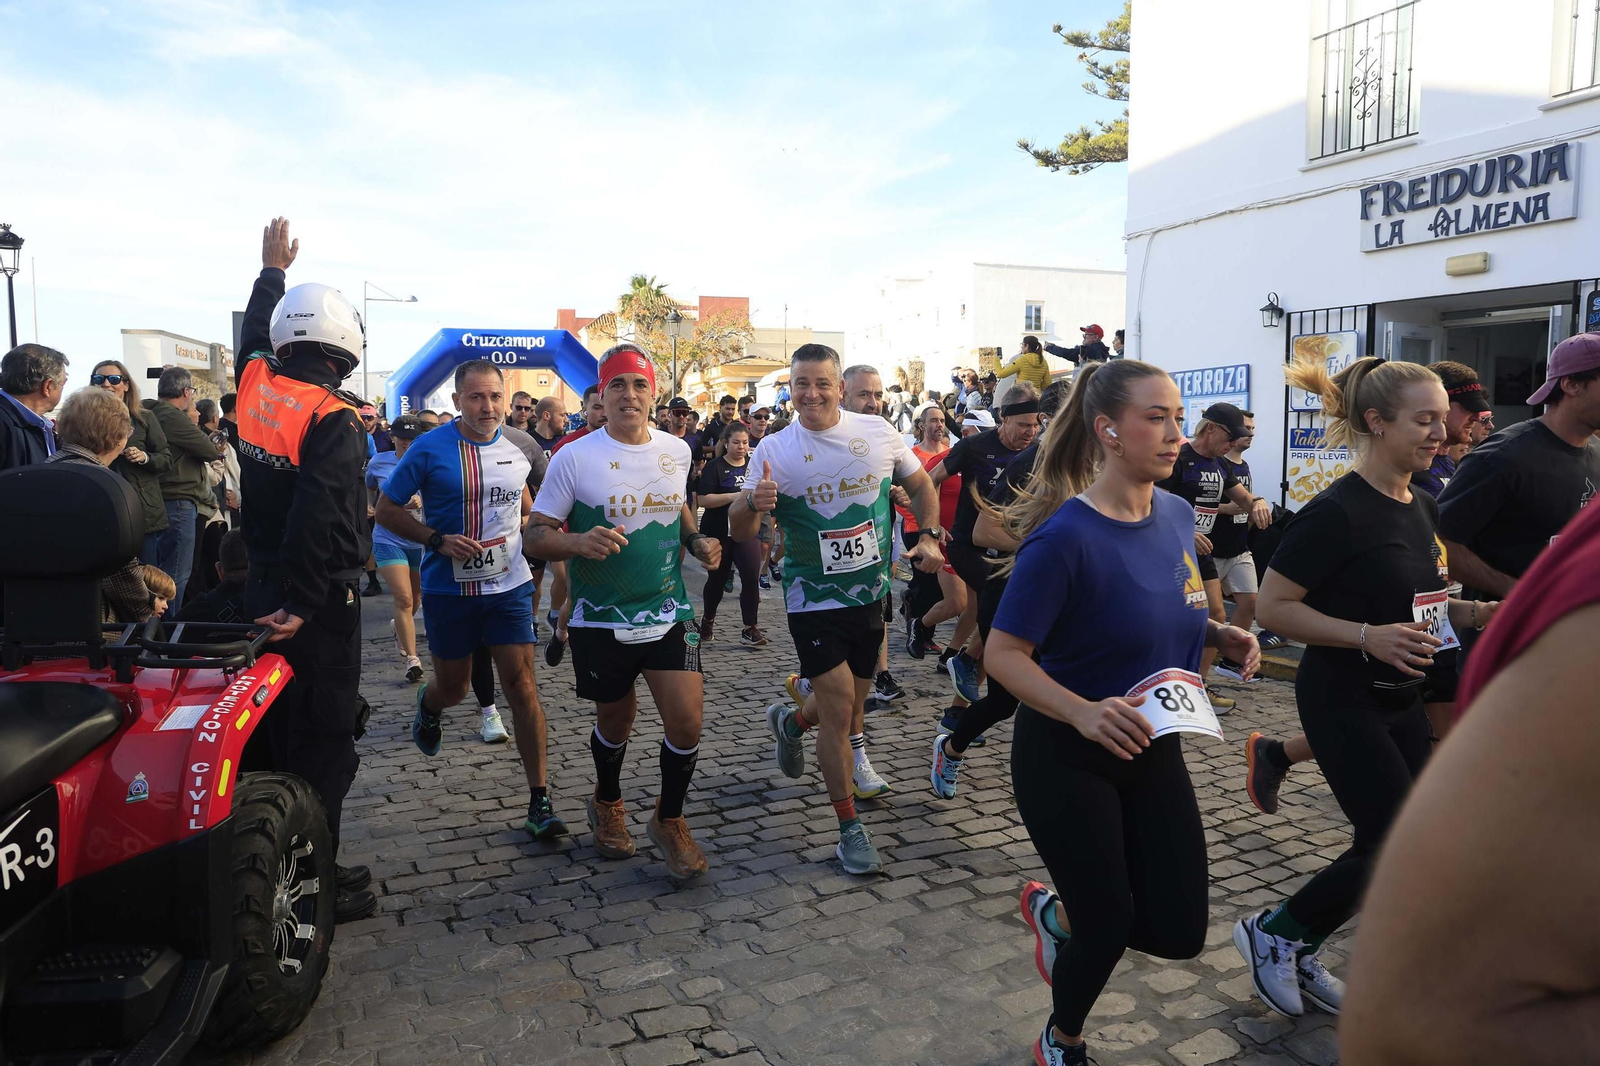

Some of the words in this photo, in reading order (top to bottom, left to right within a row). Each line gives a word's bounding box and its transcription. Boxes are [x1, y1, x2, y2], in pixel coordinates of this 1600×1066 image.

[1360, 142, 1570, 220] FREIDURIA
[1374, 219, 1405, 249] LA
[1427, 192, 1551, 238] ALMENA
[461, 332, 546, 350] Cruzcampo
[491, 351, 517, 364] 0.0
[1174, 366, 1247, 397] TERRAZA
[1291, 452, 1316, 460] PARA
[1200, 471, 1219, 482] XVI
[805, 482, 835, 506] 10
[846, 487, 870, 498] EURAFRICA
[606, 494, 638, 518] 10
[649, 506, 674, 514] EURAFRICA
[1195, 513, 1213, 527] 273
[462, 548, 495, 570] 284
[830, 536, 865, 561] 345
[198, 675, 257, 743] PROTECCION
[1153, 684, 1196, 713] 88
[188, 762, 210, 830] CIVIL
